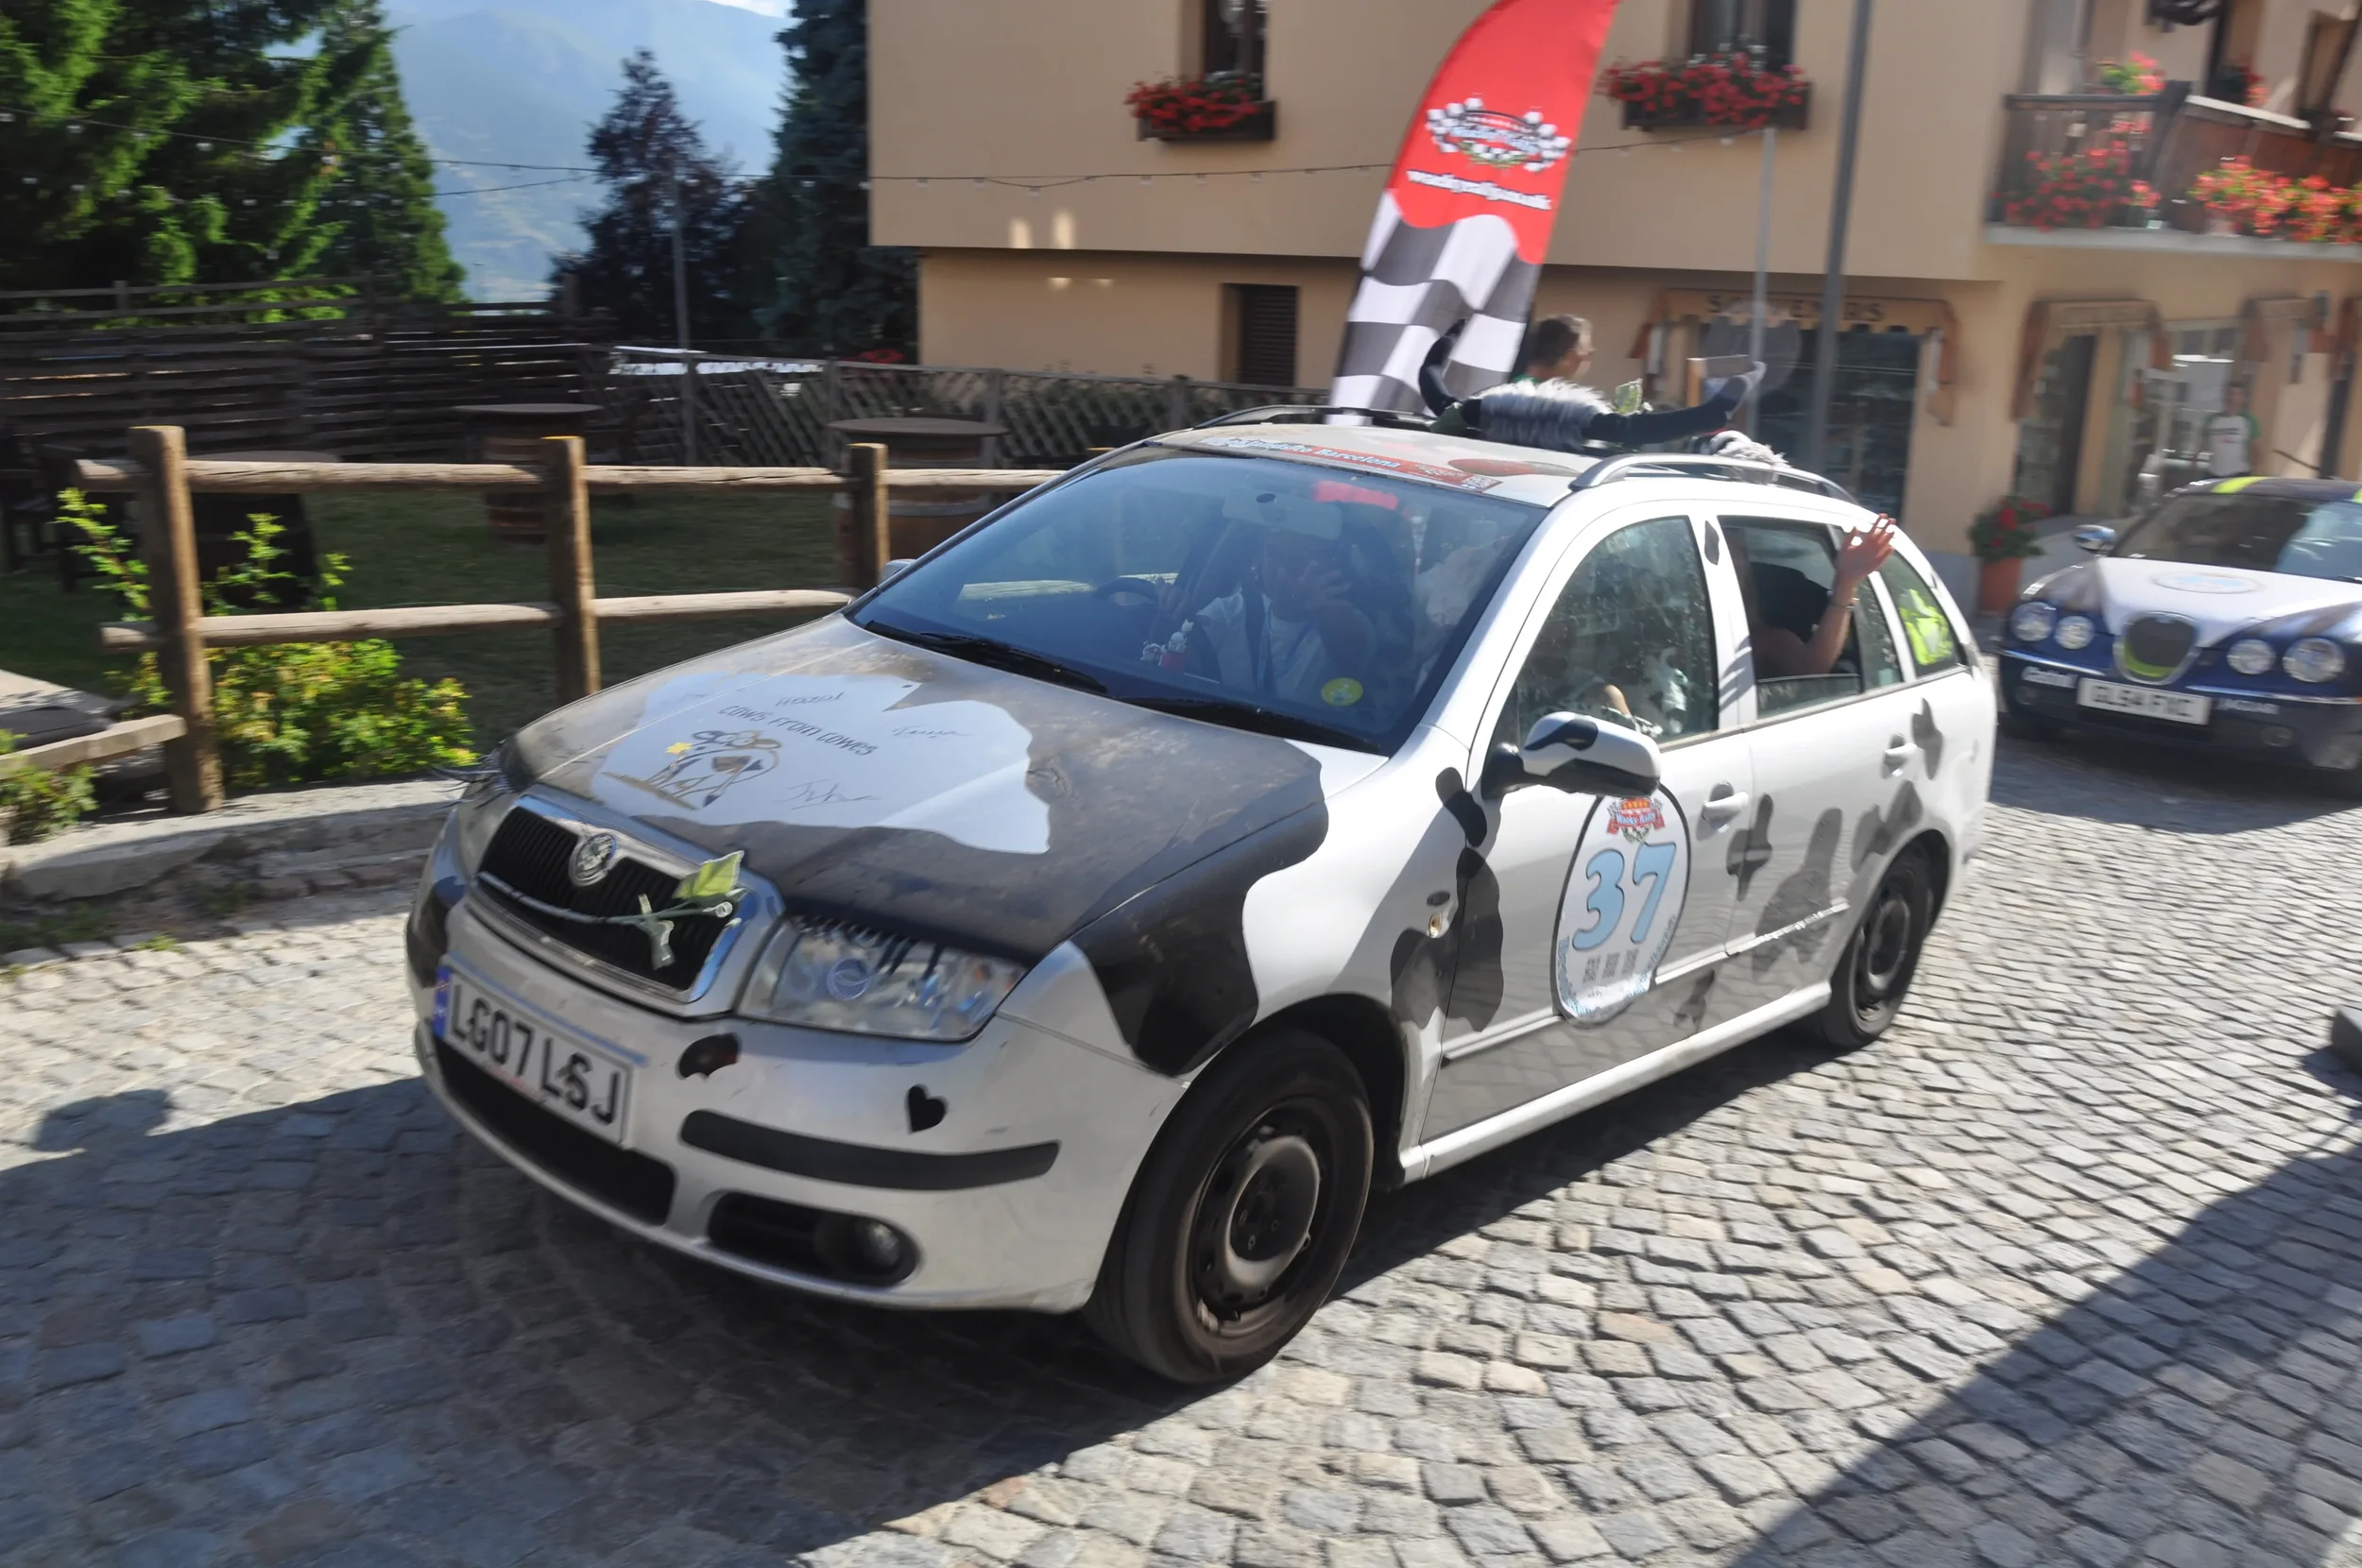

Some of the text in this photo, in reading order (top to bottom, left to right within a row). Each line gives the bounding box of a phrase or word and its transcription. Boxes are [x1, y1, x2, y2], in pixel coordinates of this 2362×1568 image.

[1313, 449, 1400, 469] Barcelona
[1572, 842, 1677, 952] 37
[451, 983, 622, 1125] LG07 LSJ
